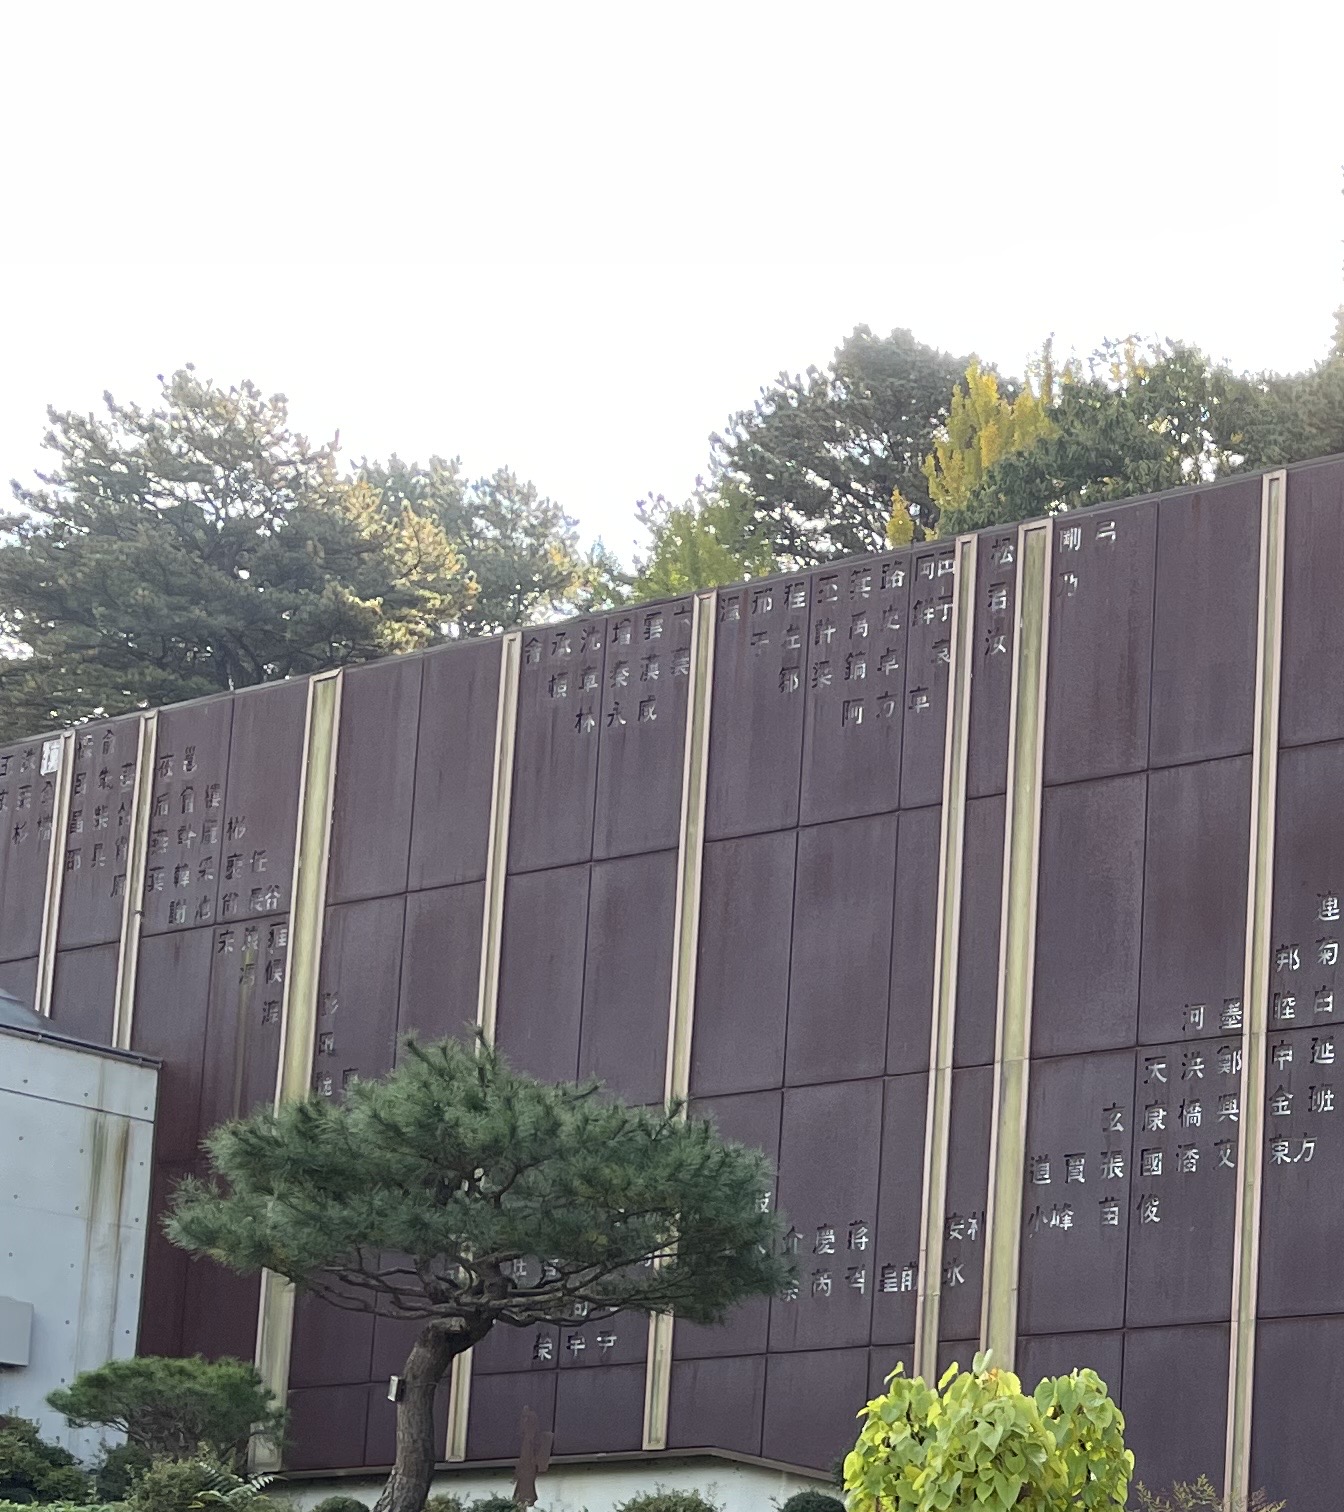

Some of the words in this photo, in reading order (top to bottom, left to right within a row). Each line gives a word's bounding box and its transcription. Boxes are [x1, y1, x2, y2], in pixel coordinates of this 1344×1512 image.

[1182, 1003, 1206, 1031] 河
[1181, 1051, 1205, 1081] 洪
[1269, 1084, 1293, 1116] 金
[1308, 1083, 1334, 1113] 班
[1102, 1102, 1125, 1132] 玄
[1100, 1150, 1125, 1180] 張
[1140, 1147, 1163, 1177] 國
[813, 1223, 835, 1254] 慶
